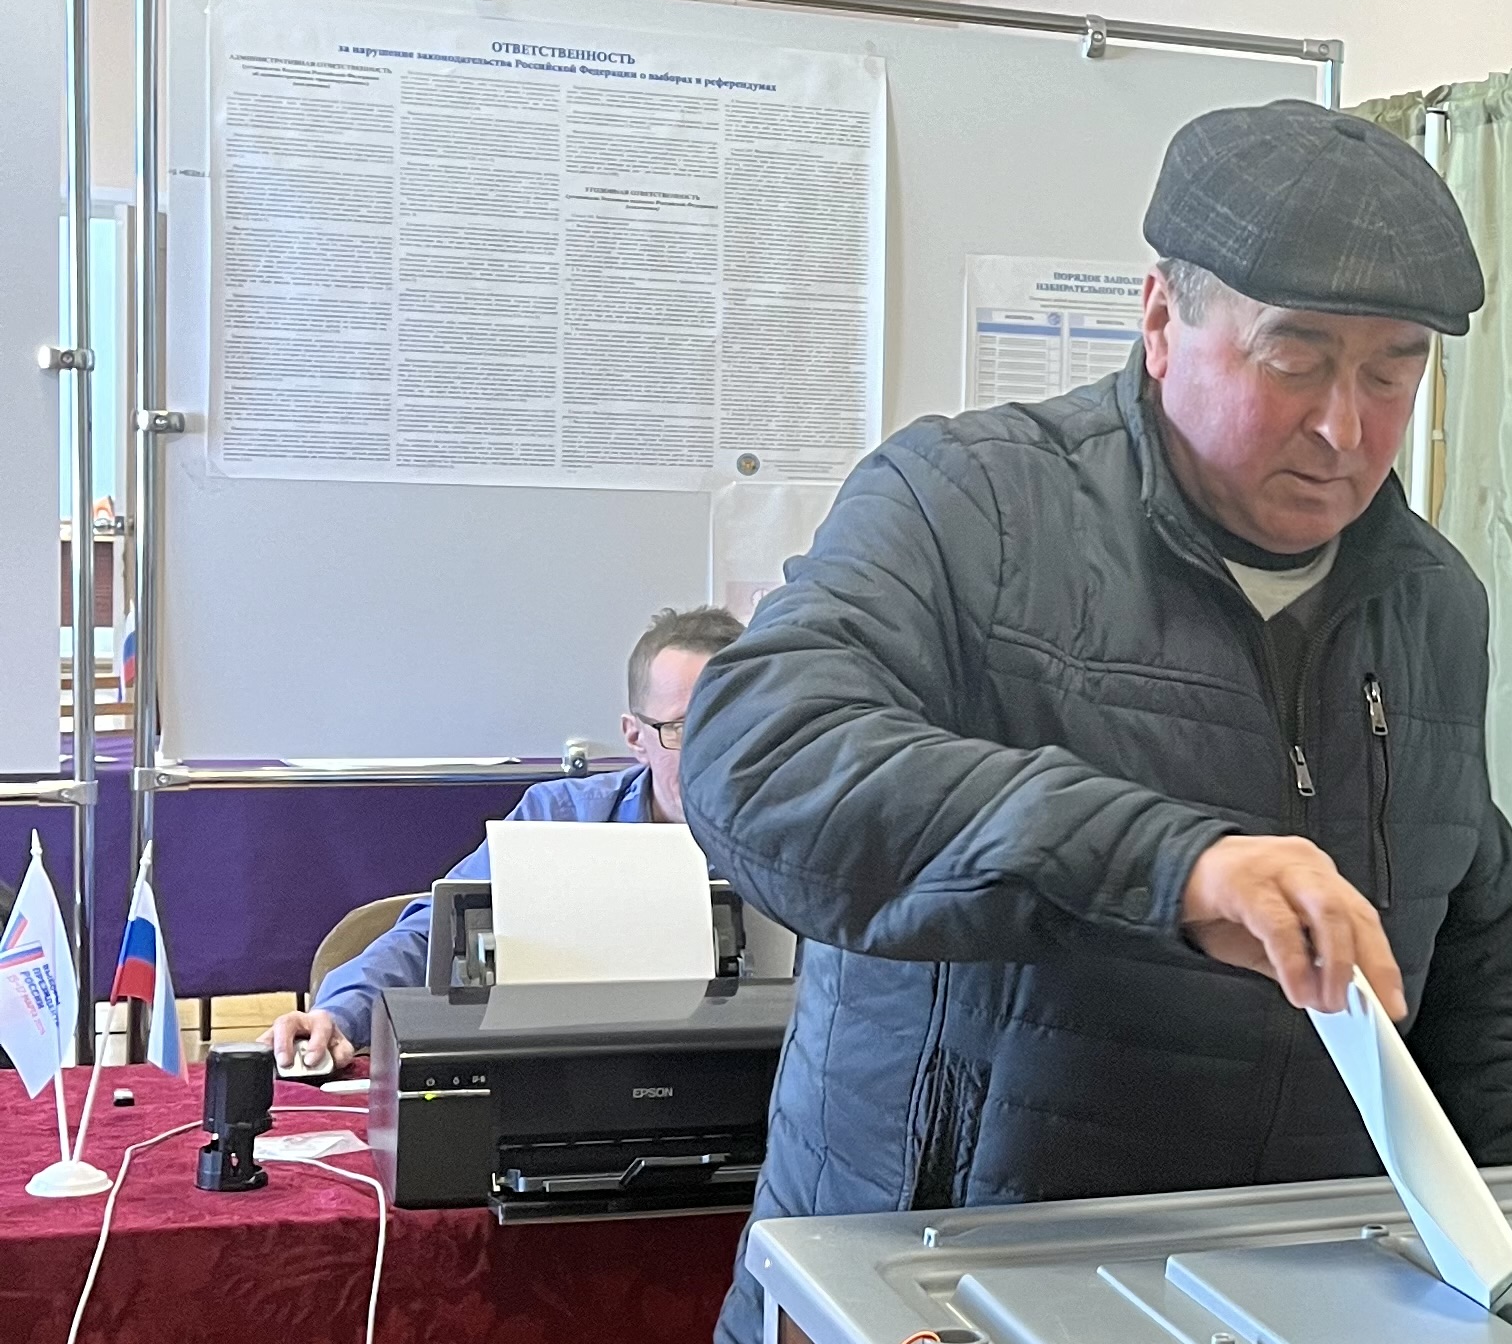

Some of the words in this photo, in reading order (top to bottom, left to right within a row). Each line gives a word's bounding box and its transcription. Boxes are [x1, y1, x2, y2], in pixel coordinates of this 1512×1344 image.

[491, 41, 636, 65] ОТВЕТСТВЕННОСТЬ
[353, 46, 415, 59] нарушение
[416, 52, 513, 68] законодательства
[515, 59, 577, 74] Российской
[578, 65, 637, 79] Федерации
[648, 72, 693, 85] выборах
[704, 77, 777, 92] референдумах
[1053, 272, 1102, 283] ПОРЯДОК
[1036, 282, 1125, 296] ИЗБИРАТЕЛЬНОГО
[632, 1087, 674, 1099] EPSON
